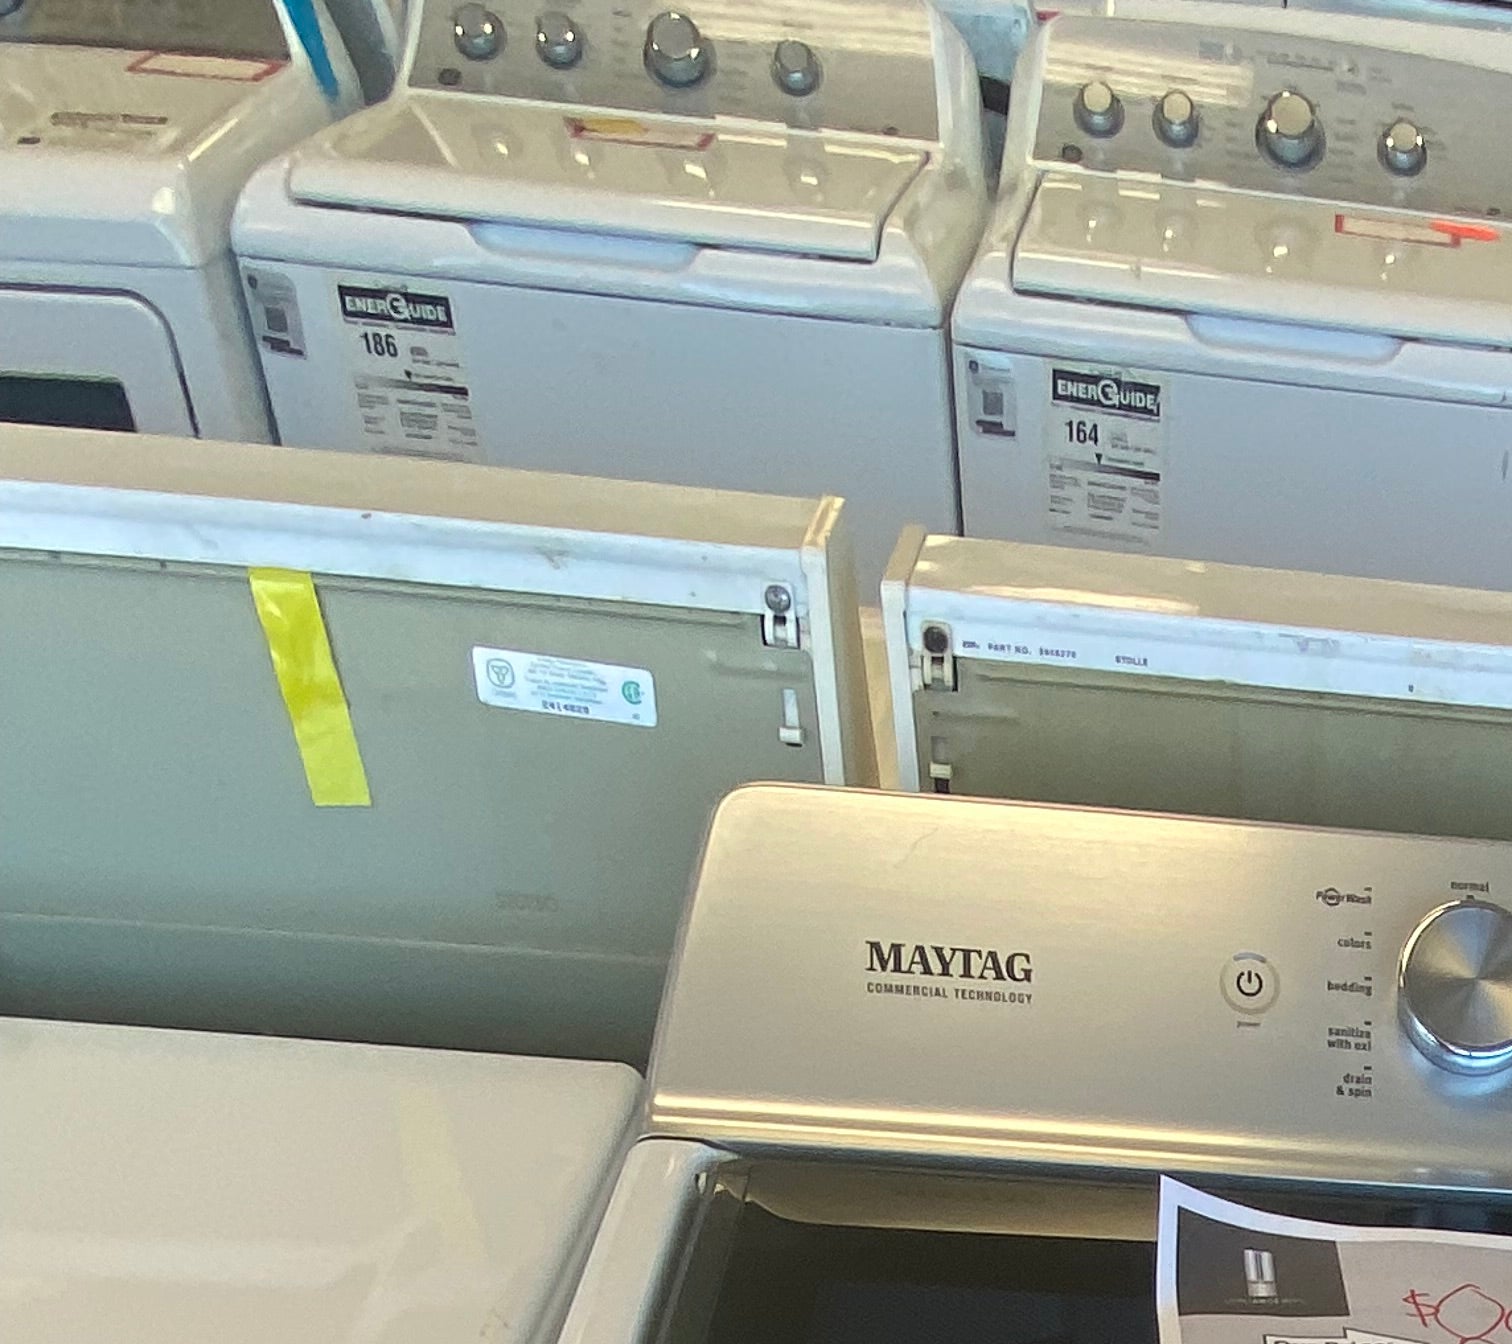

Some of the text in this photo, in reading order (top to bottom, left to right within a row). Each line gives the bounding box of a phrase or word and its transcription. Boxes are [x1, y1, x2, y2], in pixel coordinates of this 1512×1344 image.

[344, 293, 448, 322] ENERGUIDE
[361, 332, 399, 358] 186
[1056, 379, 1158, 413] ENERGUIDE
[1065, 419, 1099, 446] 164
[1450, 881, 1489, 892] normal
[1337, 937, 1372, 949] colors
[865, 940, 1033, 983] MAYTAG
[867, 982, 1033, 1004] COMMERCIAL TECHNOLOGY
[1327, 980, 1373, 996] bedding
[1328, 1027, 1372, 1039] sanitize
[1327, 1039, 1352, 1050] with
[1343, 1072, 1373, 1084] drain
[1336, 1085, 1373, 1099] & spin
